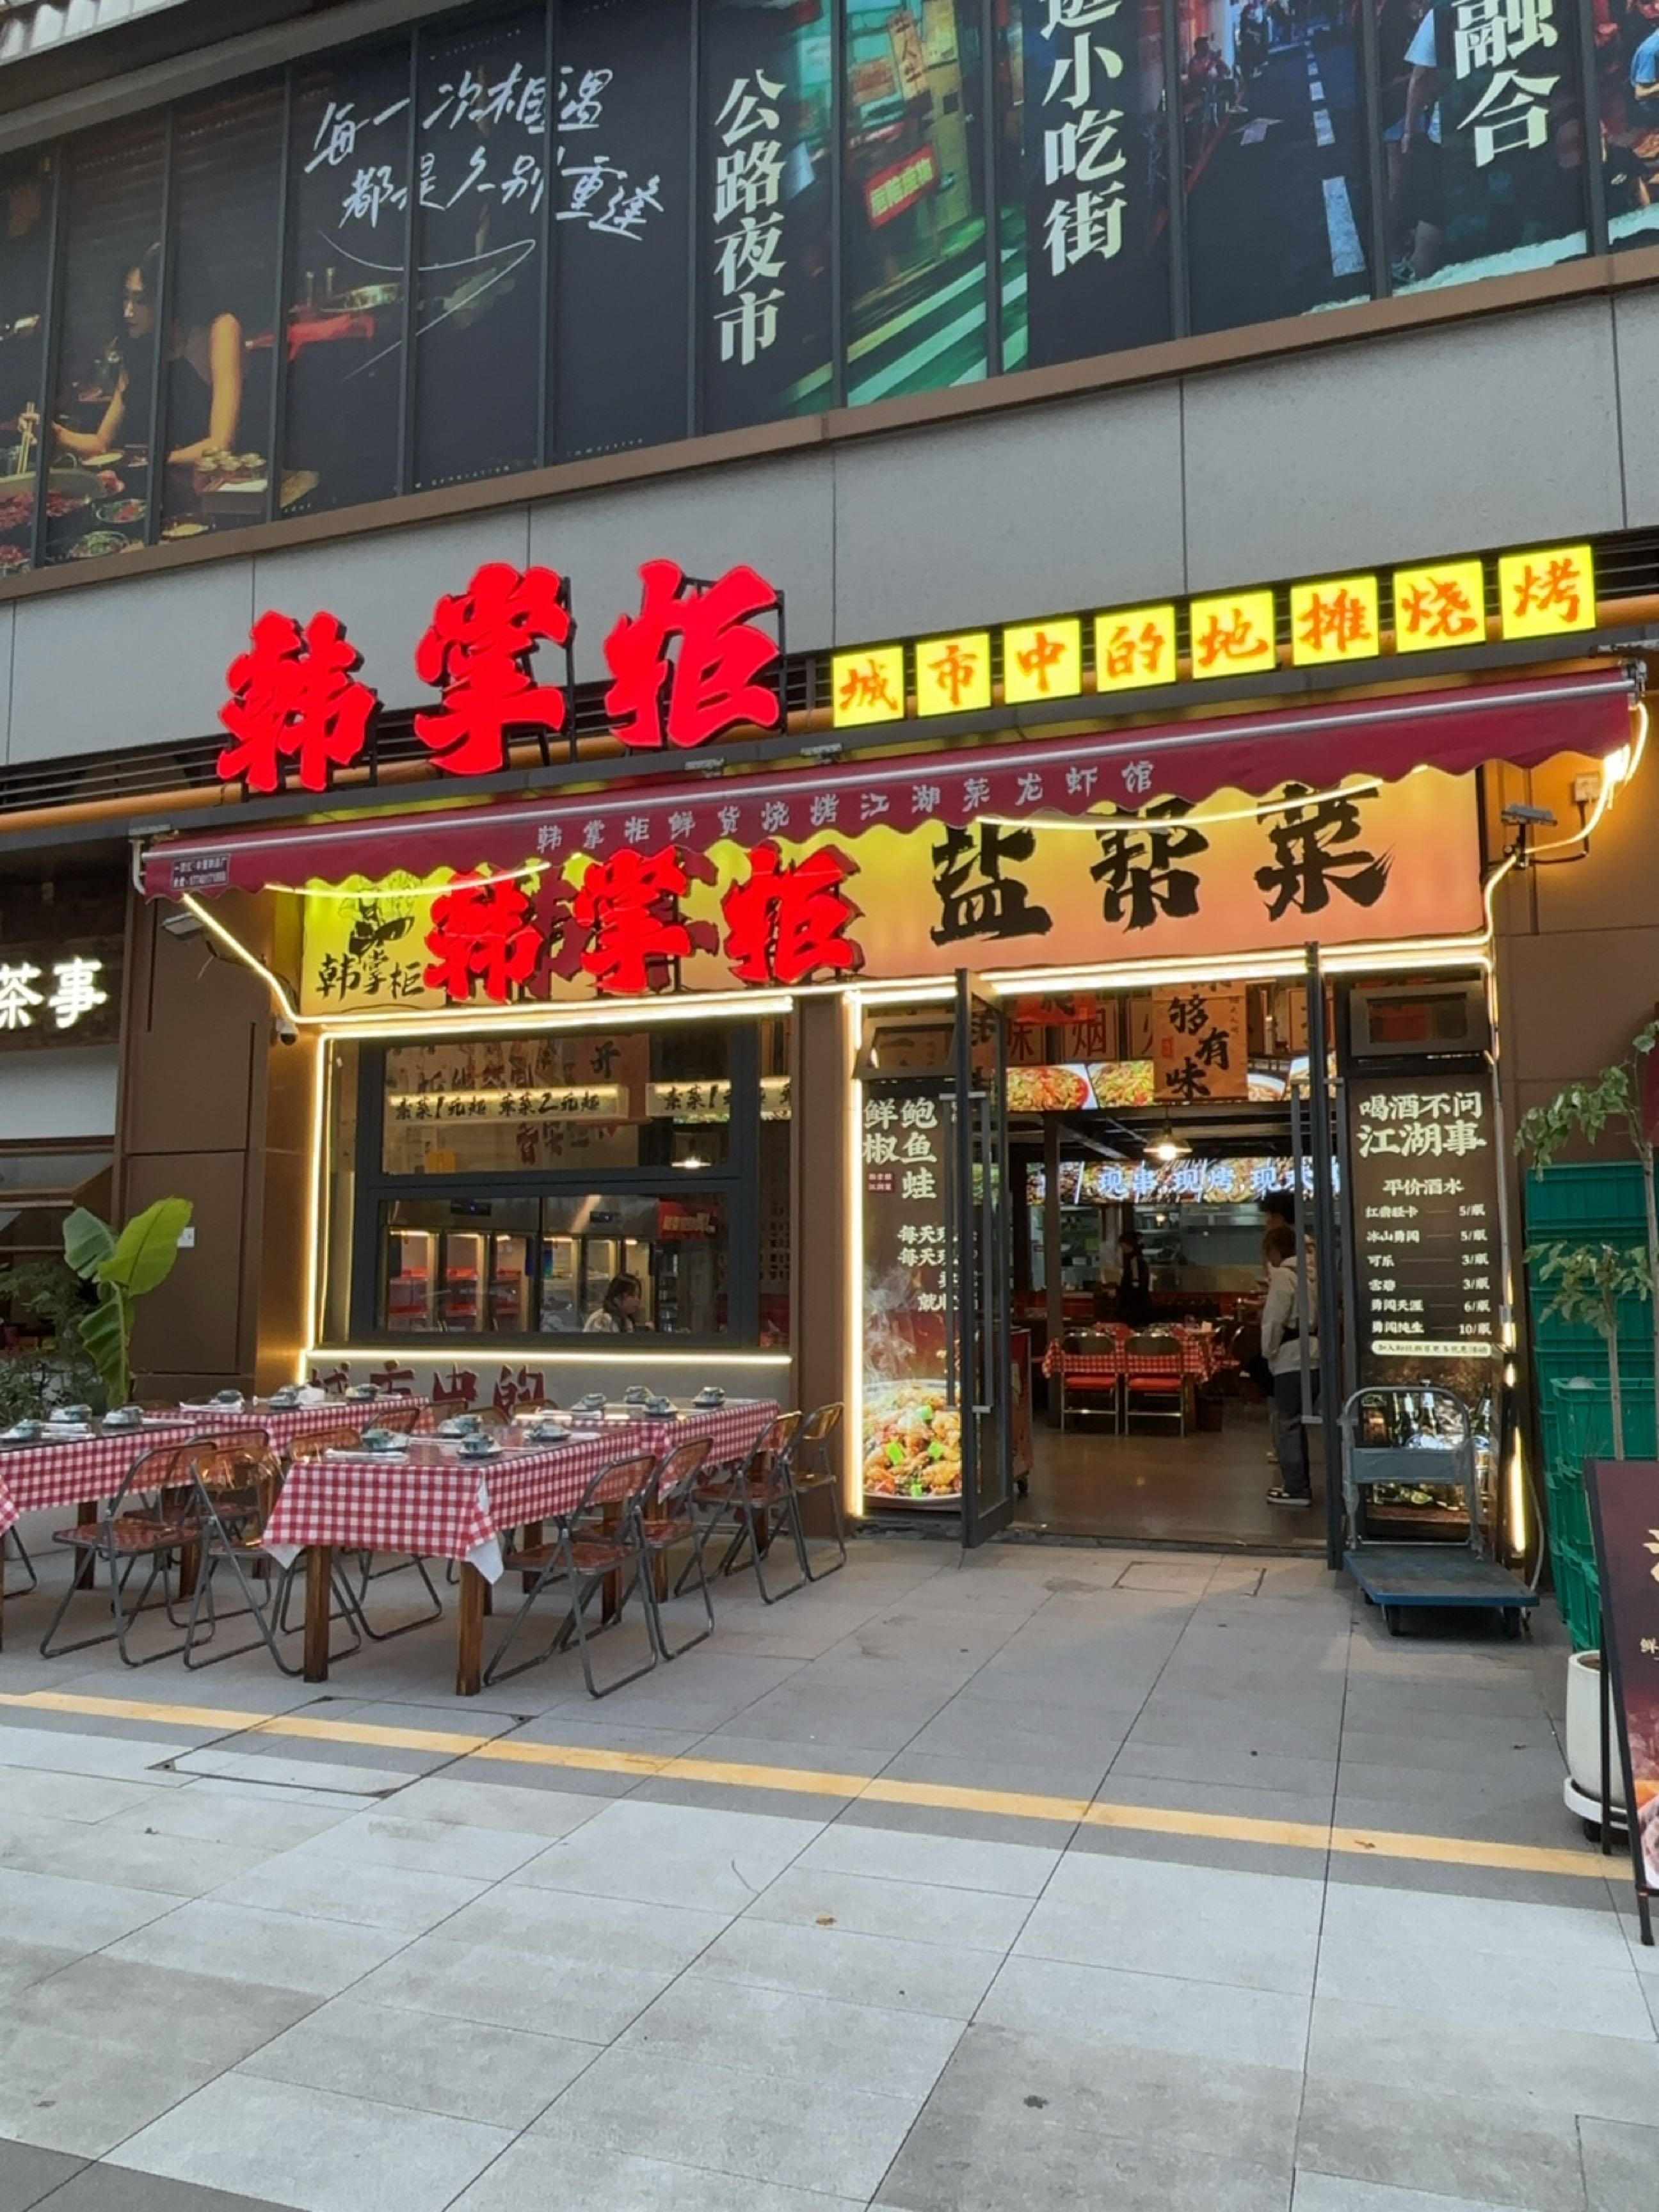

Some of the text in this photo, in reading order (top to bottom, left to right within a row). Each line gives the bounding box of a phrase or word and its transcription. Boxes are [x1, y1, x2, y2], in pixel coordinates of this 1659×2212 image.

[305, 63, 613, 173] 每一次相遇
[339, 146, 664, 240] 都是久别重逢
[712, 69, 787, 365] 公路夜市
[216, 559, 781, 792] 韩掌柜
[840, 559, 1582, 716] 城市中的地摊烧烤
[930, 780, 1395, 947] 盐帮菜
[424, 846, 855, 1004] 韩掌柜
[0, 956, 108, 1029] 茶事
[316, 954, 425, 1002] 韩掌柜
[863, 1097, 901, 1165] 鲜椒
[900, 1096, 938, 1199] 鲍鱼蛙
[1356, 1121, 1487, 1158] 江湖事
[1358, 1091, 1482, 1121] 喝酒不问
[1382, 1178, 1464, 1196] 平价酒水
